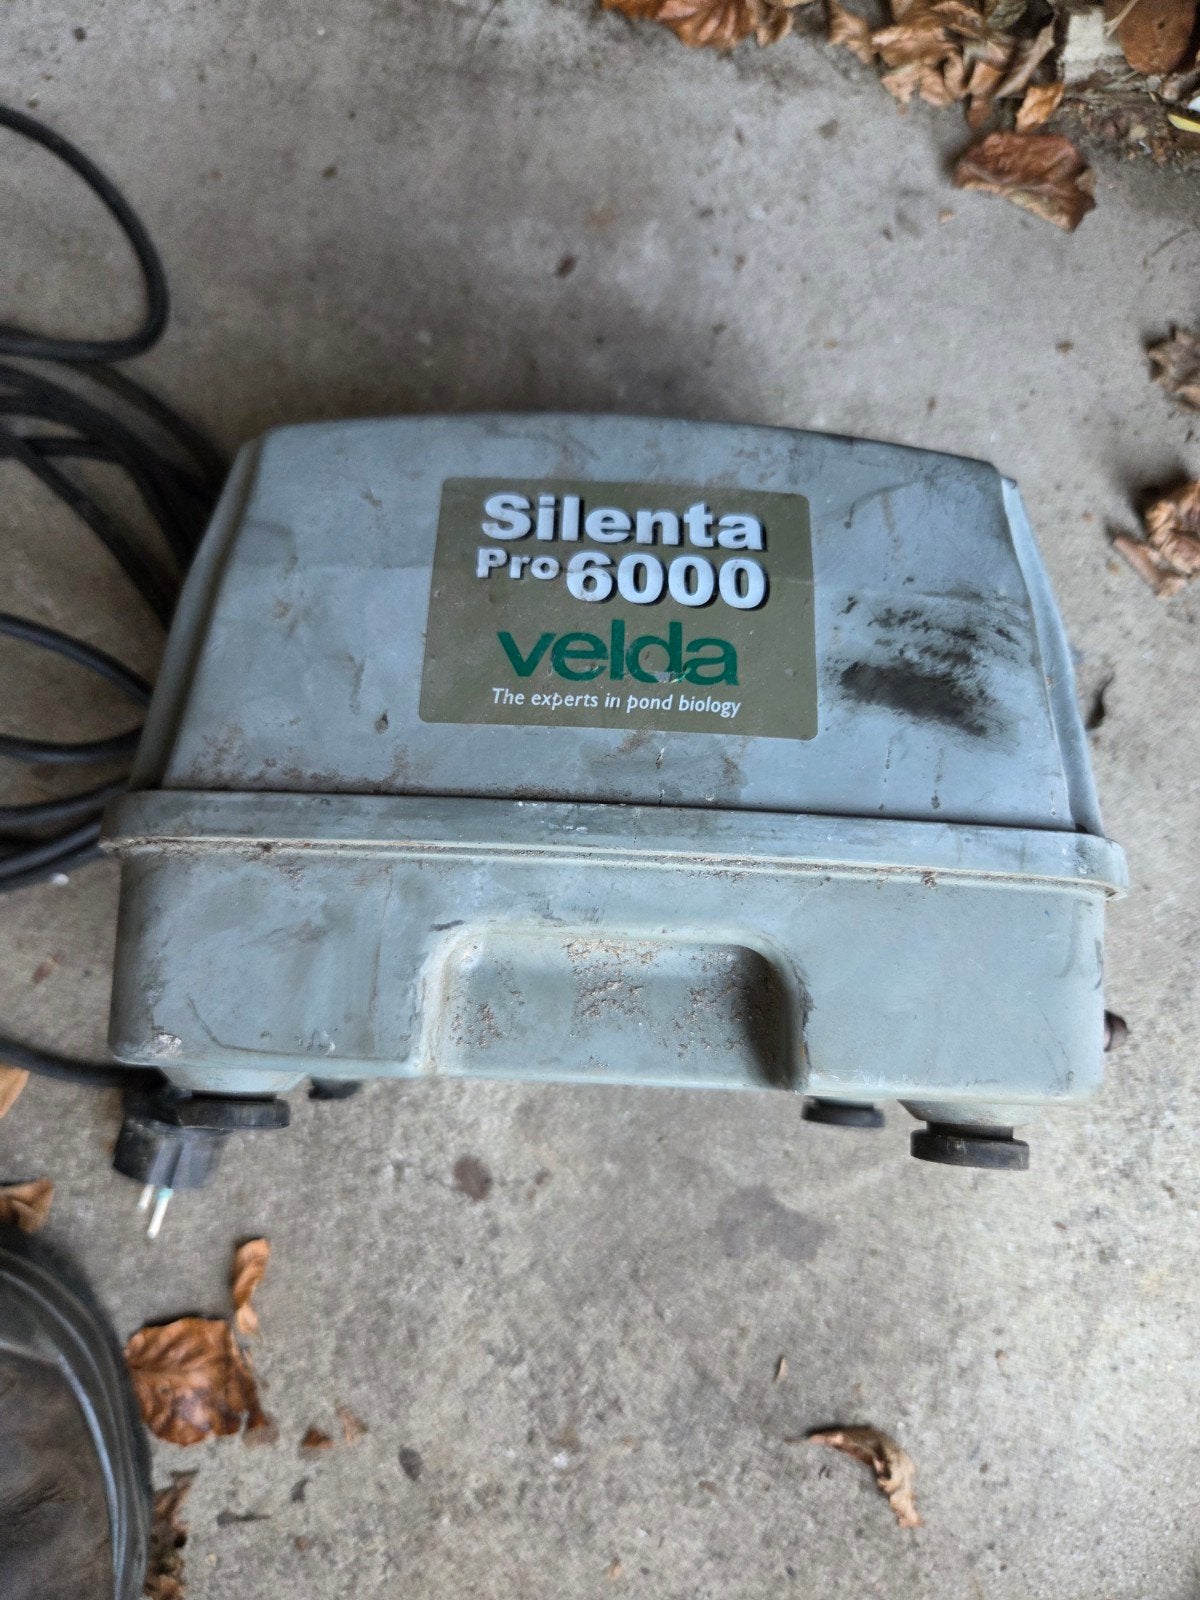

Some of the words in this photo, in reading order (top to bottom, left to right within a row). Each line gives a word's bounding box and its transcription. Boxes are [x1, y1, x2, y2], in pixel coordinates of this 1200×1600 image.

[481, 493, 765, 550] Silenta
[476, 547, 560, 580] Pro
[566, 550, 767, 609] 6000
[496, 619, 739, 686] velda
[491, 687, 525, 705] The
[531, 691, 599, 710] experts
[605, 692, 621, 709] in
[626, 694, 674, 713] pond
[678, 695, 741, 718] biology
